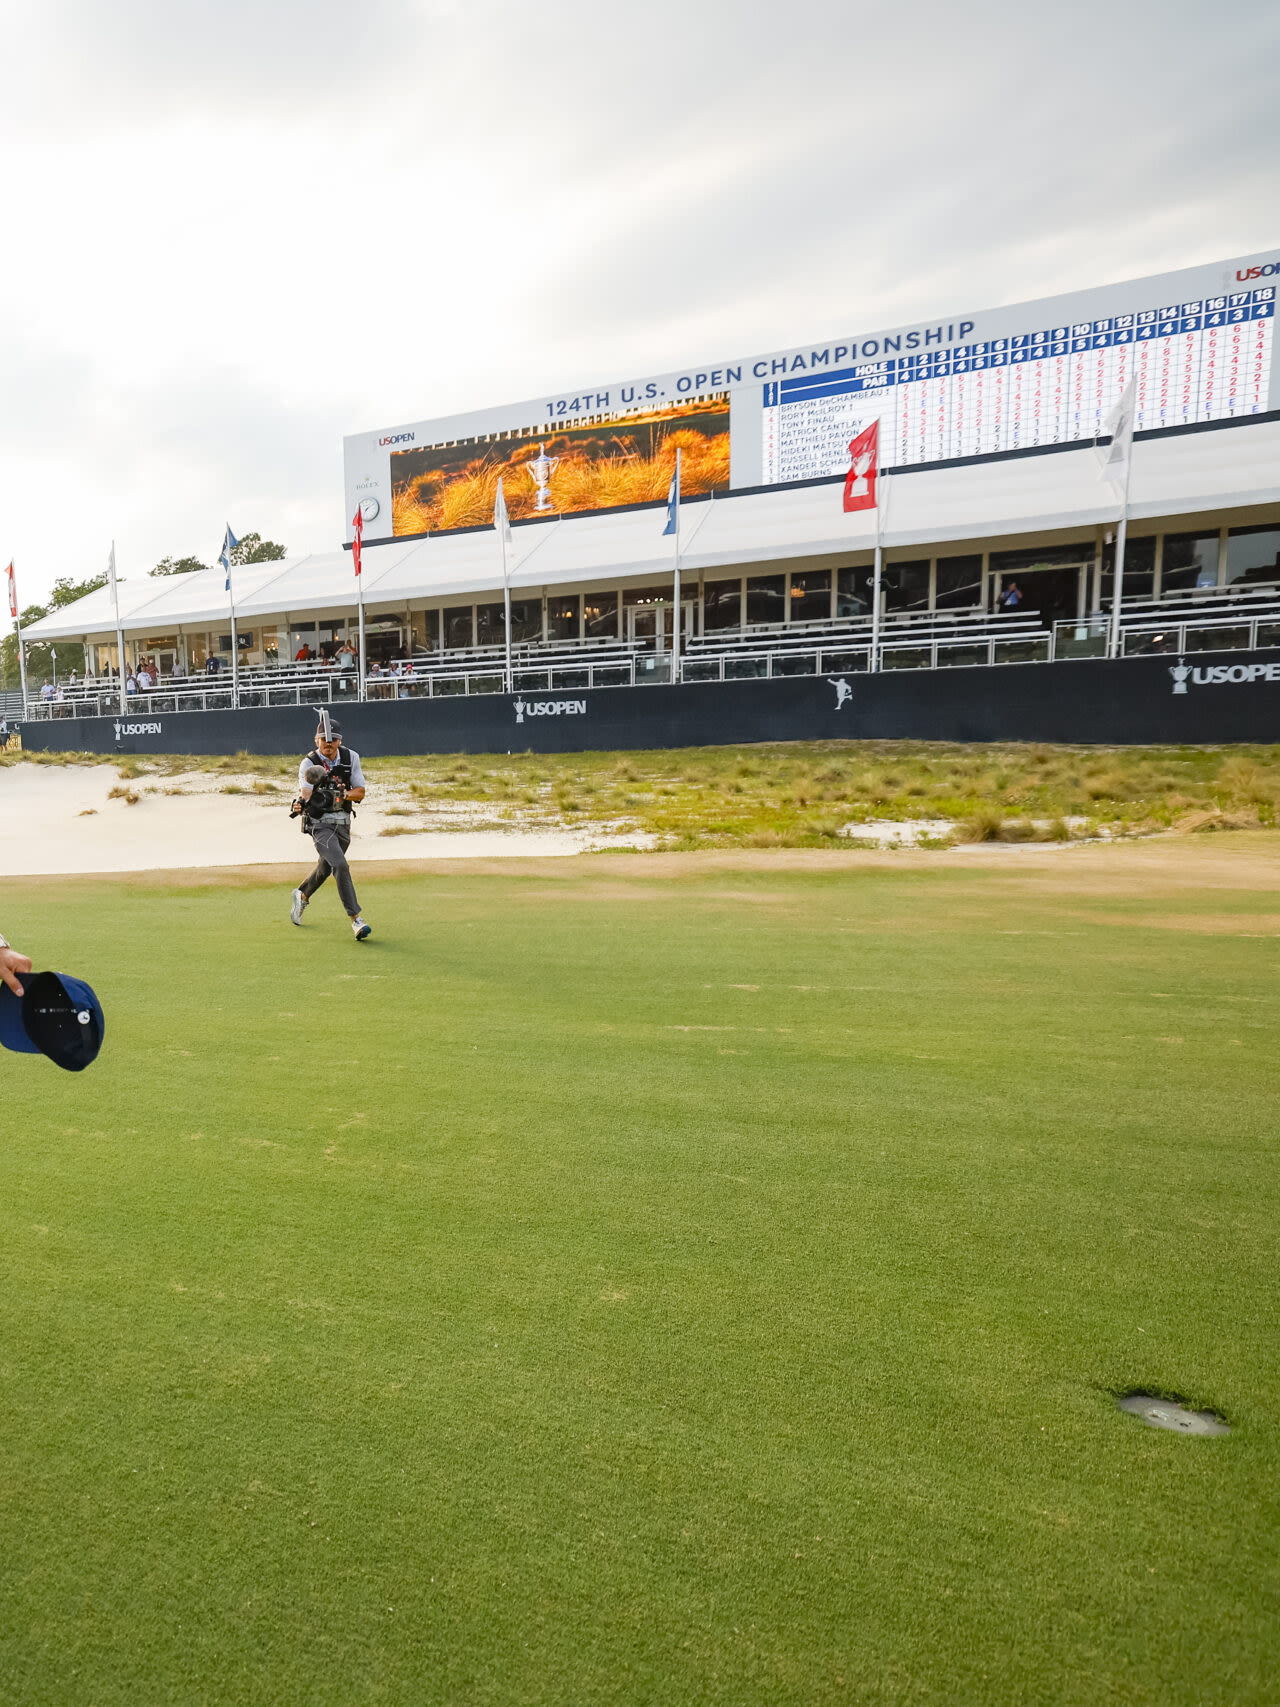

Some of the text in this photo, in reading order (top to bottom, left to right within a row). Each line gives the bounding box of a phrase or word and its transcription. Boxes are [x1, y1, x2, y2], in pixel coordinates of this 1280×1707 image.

[855, 289, 1272, 377] HOLE 1 2 3 4 5 6 7 8 9 10 11 12 13 14 15 16 17 18
[862, 304, 1268, 389] PAR 4 4 4 4 5 3 4 4 3 5 4 4 4 4 3 4 3 4
[546, 320, 975, 417] 124TH U.S. OPEN CHAMPIONSHIP
[781, 401, 816, 412] BRYSON
[781, 411, 804, 421] RORY
[782, 420, 804, 430] TONY
[808, 415, 835, 425] FINAU
[781, 426, 817, 438] PATRICK
[821, 419, 863, 432] CANTLAY
[379, 432, 415, 446] USOPEN
[781, 435, 826, 446] MATTHIEU
[829, 429, 859, 439] PAVON
[781, 446, 810, 455] HIDEKI
[781, 453, 819, 464] RUSSELL
[781, 462, 817, 473] XANDER
[781, 473, 799, 481] SAM
[801, 469, 832, 479] BURNS
[526, 700, 587, 716] USOPEN
[122, 722, 161, 735] USOPEN
